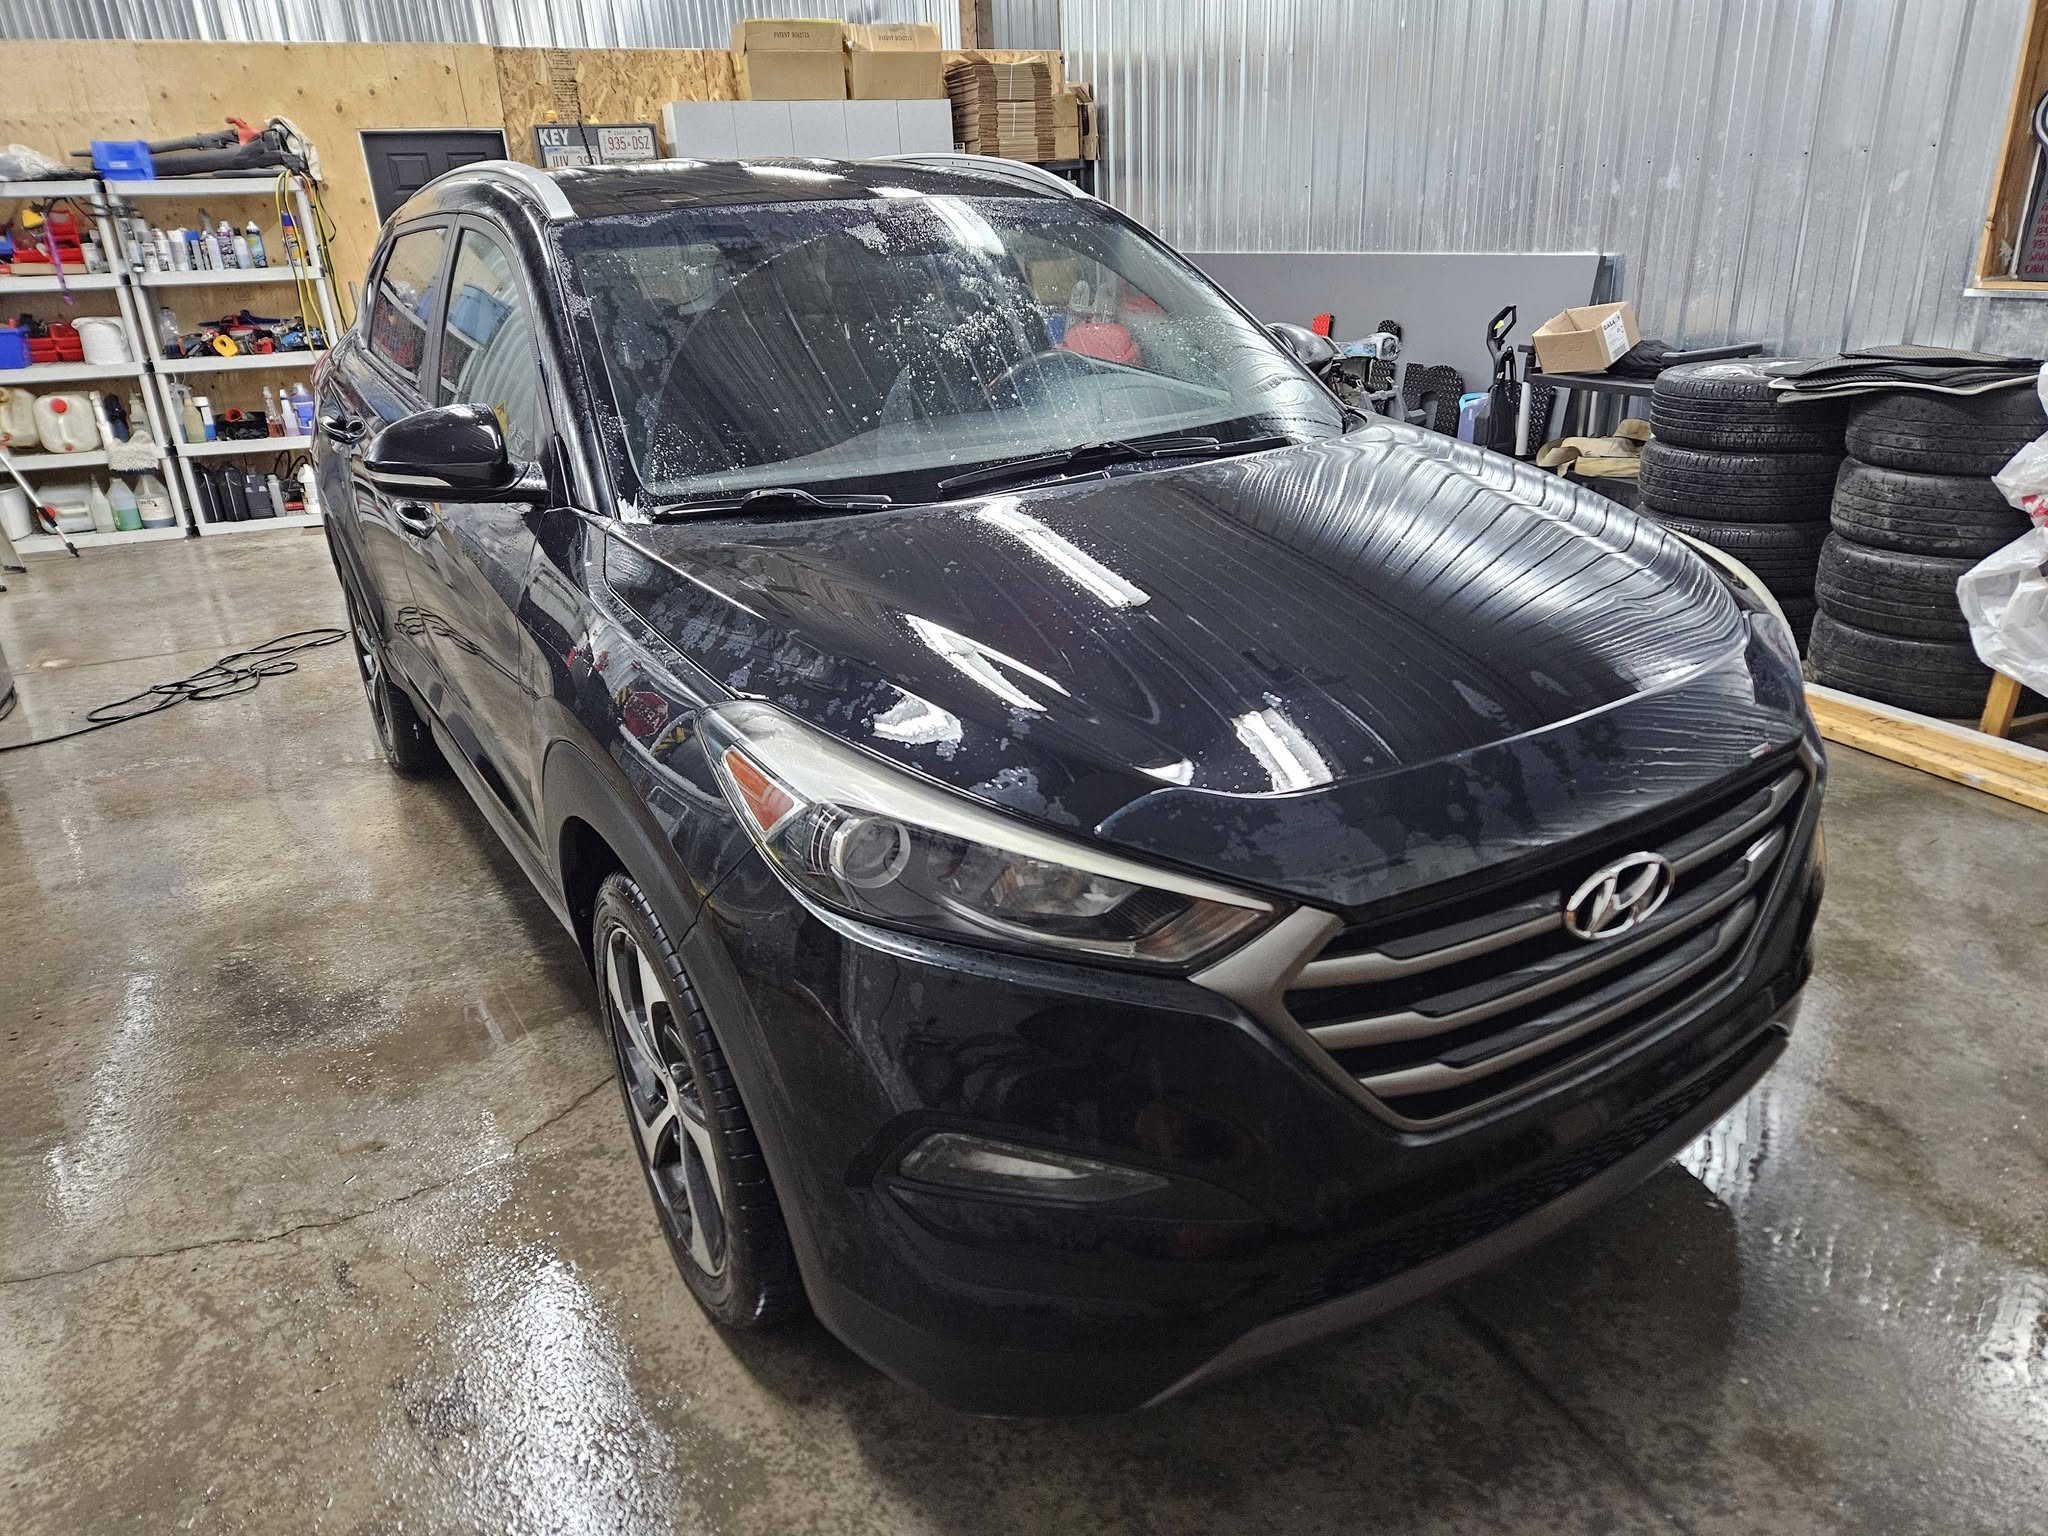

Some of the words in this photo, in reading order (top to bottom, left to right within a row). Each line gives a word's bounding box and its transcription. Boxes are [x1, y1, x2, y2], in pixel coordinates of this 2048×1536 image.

[538, 129, 569, 145] KEY
[608, 136, 626, 150] 935
[632, 136, 650, 150] DSZ
